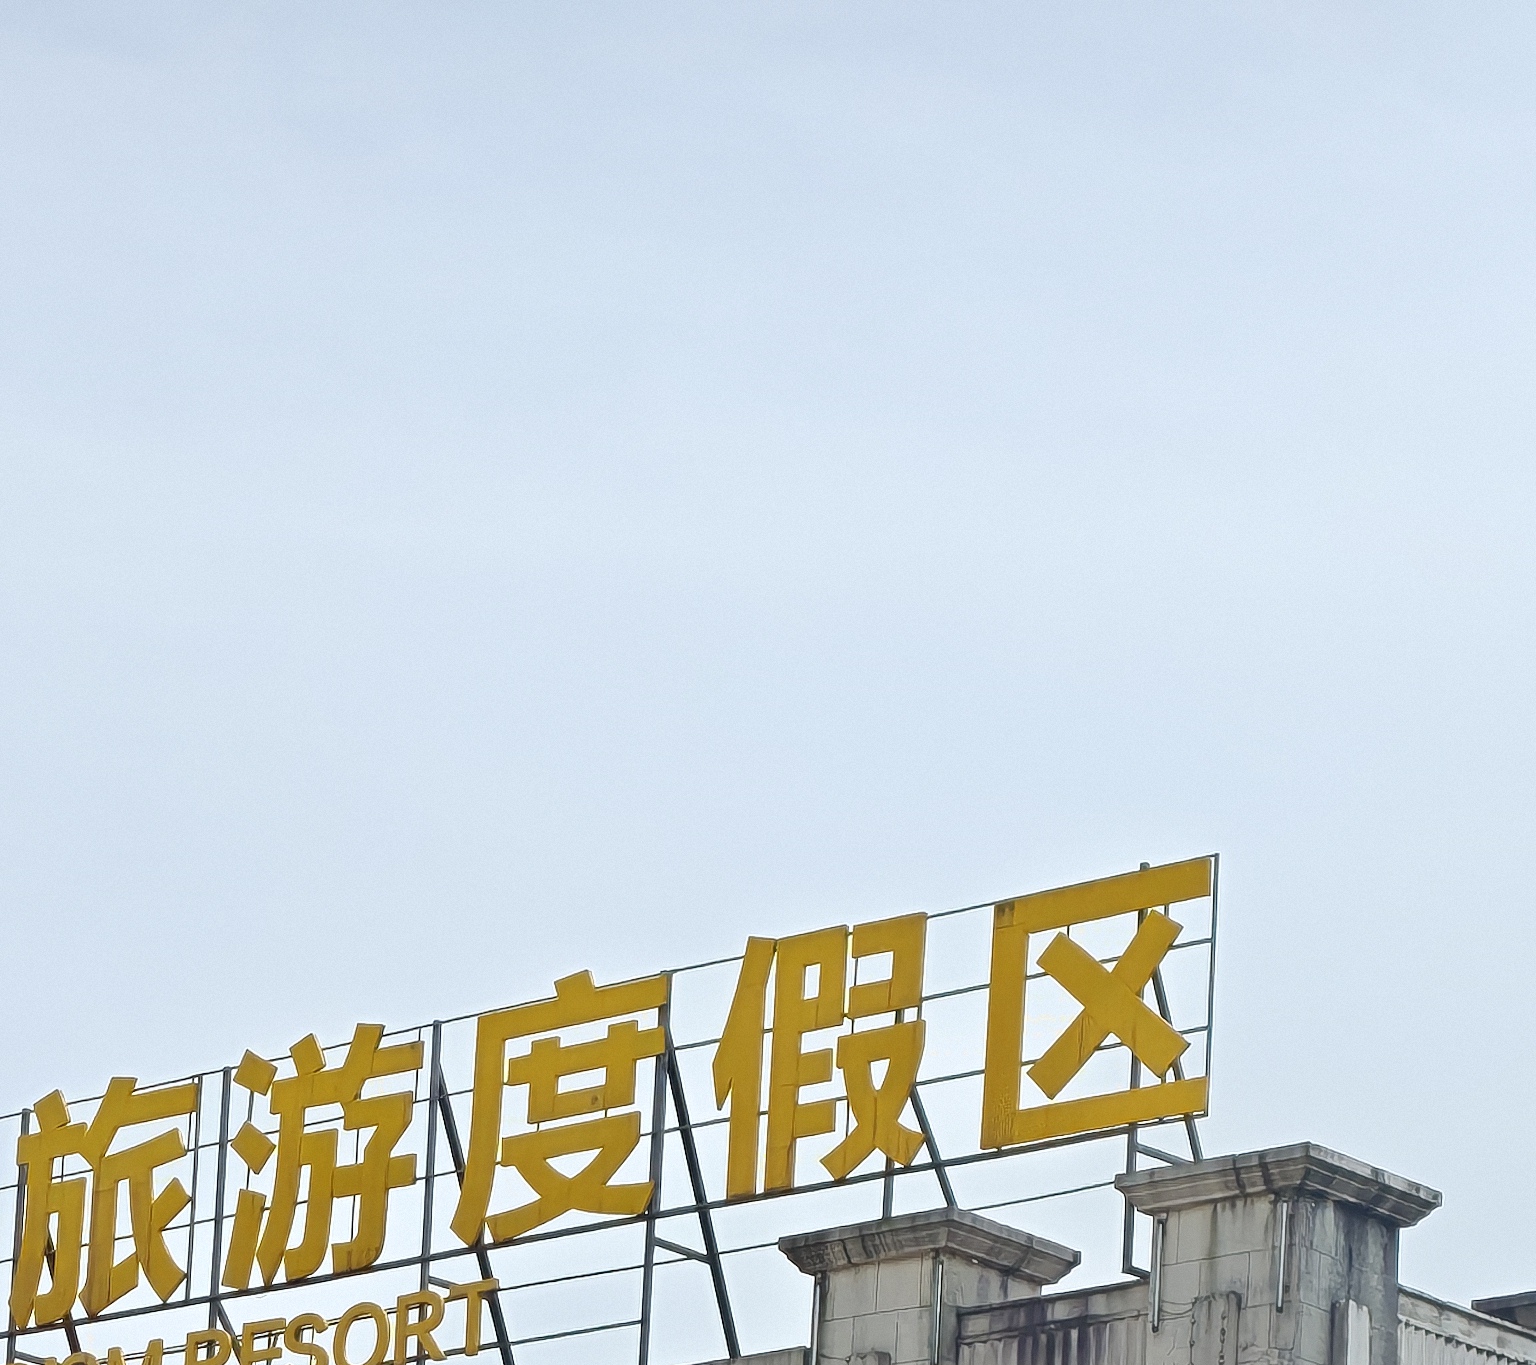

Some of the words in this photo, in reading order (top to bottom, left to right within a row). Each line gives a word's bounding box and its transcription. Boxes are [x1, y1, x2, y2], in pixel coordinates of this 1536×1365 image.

[9, 858, 1212, 1331] 旅游度假区
